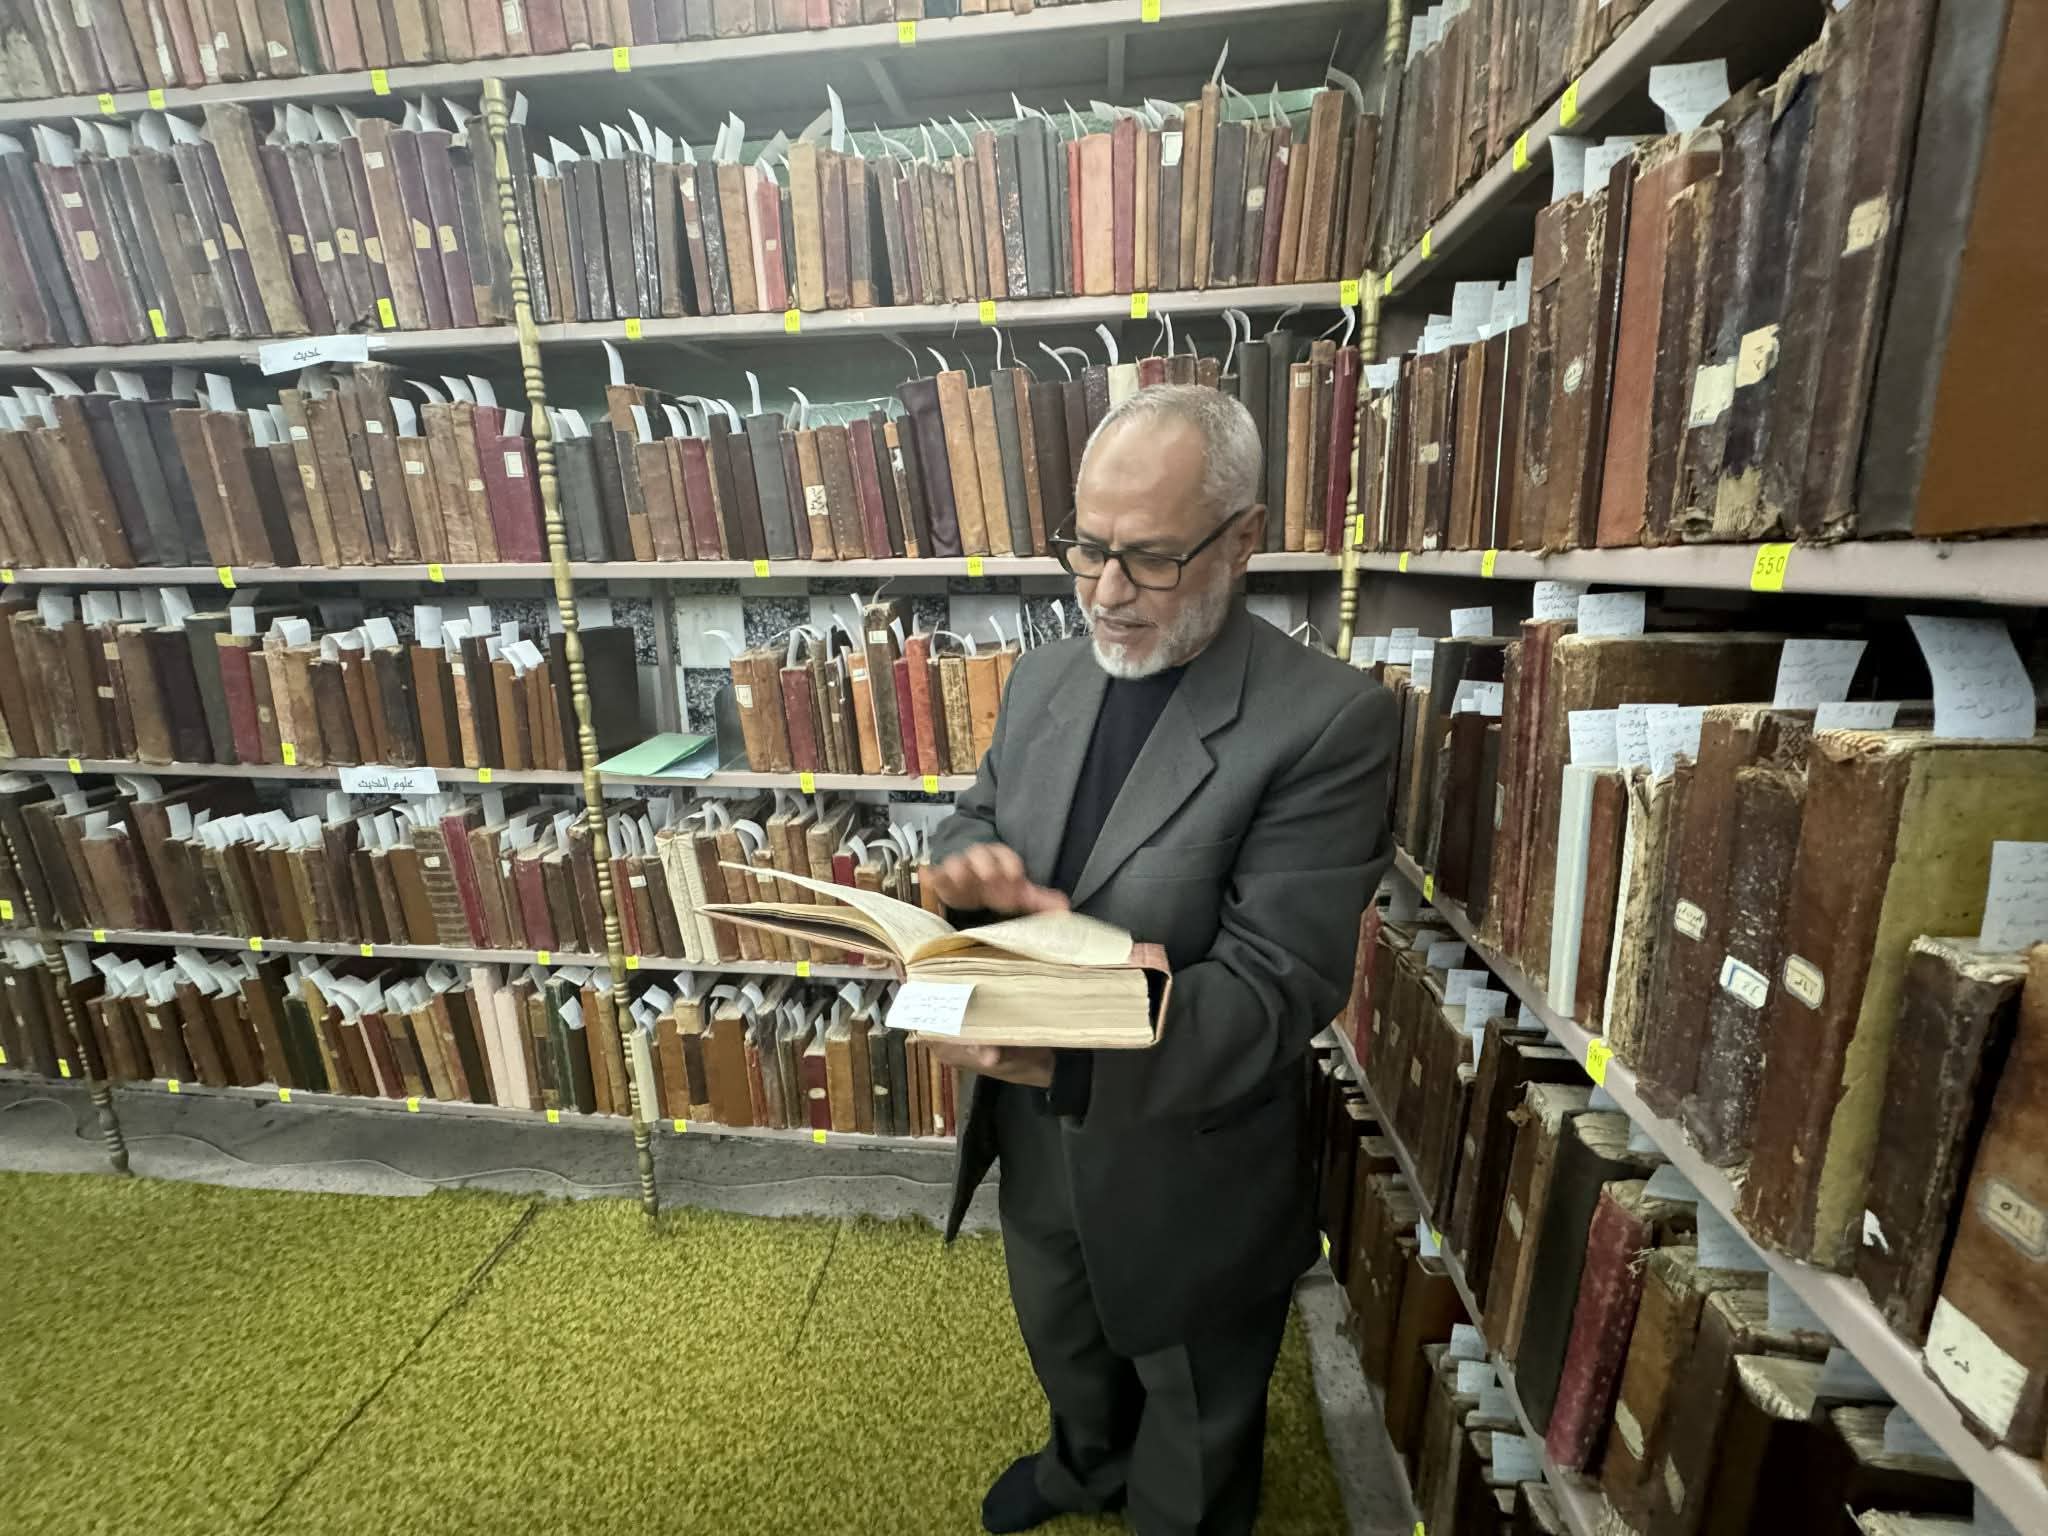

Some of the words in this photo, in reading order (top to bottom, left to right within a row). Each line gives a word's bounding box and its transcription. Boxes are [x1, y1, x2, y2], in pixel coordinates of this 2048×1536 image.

[1756, 555, 1786, 575] 550
[357, 775, 391, 791] الحديث
[393, 775, 415, 791] علوم
